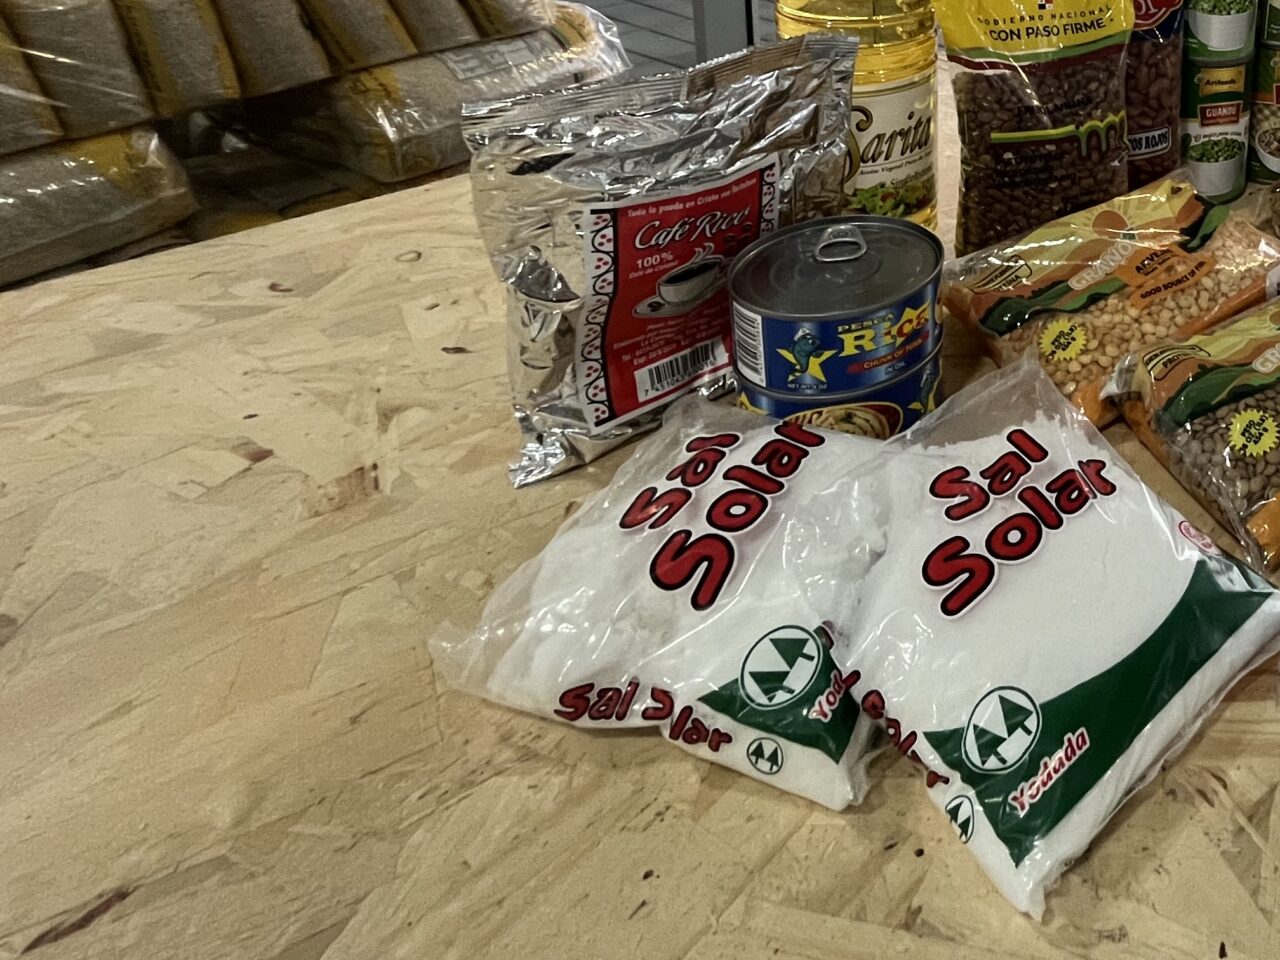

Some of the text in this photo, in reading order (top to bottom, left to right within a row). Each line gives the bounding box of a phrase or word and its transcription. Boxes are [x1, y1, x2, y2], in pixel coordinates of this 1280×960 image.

[977, 3, 1113, 26] GOBIERNO NACIONAL
[989, 16, 1106, 42] CON PASO FIRME
[628, 207, 646, 218] Todo
[635, 207, 751, 251] Café Rico
[636, 250, 674, 270] 100%
[1140, 284, 1162, 299] GOOD
[1162, 272, 1189, 291] SOURCE
[837, 313, 895, 334] PESCA
[863, 355, 894, 370] CHUNK
[619, 433, 741, 530] Sal
[929, 428, 1049, 522] Sal
[649, 421, 825, 612] Solar
[921, 458, 1117, 617] Solar
[554, 676, 640, 722] Sal
[1008, 726, 1090, 817] Yodada
